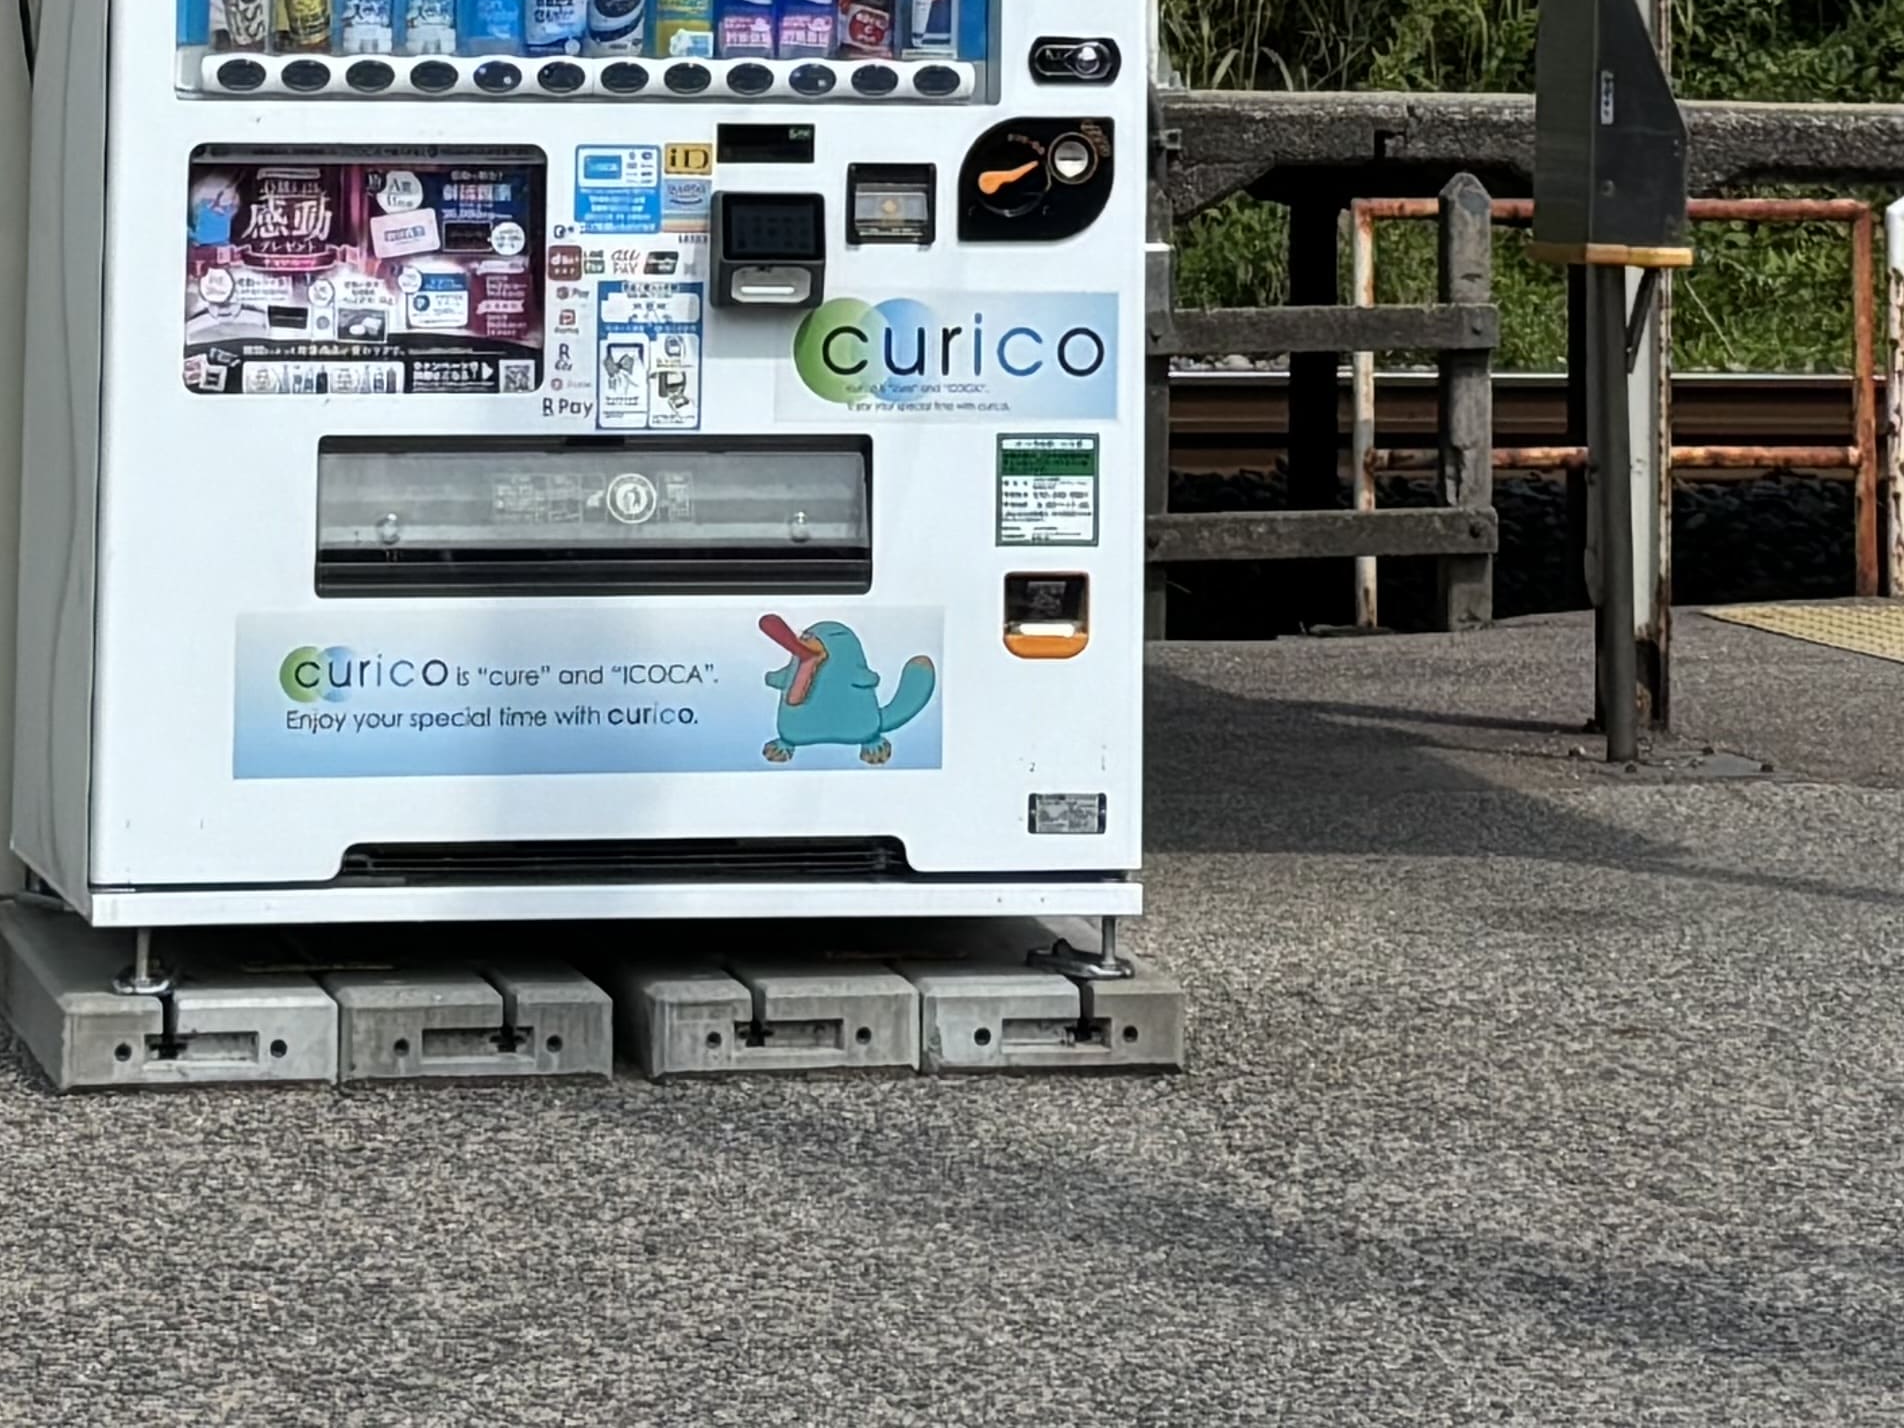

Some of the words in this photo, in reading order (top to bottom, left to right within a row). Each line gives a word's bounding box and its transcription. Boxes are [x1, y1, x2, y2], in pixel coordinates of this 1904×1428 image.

[669, 148, 710, 169] iD
[240, 193, 333, 242] 感動
[821, 312, 1106, 378] curico
[558, 398, 594, 419] Pay
[294, 653, 449, 689] curico
[456, 666, 470, 687] is
[558, 665, 604, 686] and
[286, 709, 347, 735] Enjoy
[353, 712, 404, 734] your
[409, 706, 491, 732] special
[499, 706, 547, 727] time
[554, 704, 601, 726] with
[607, 701, 699, 726] curico.
